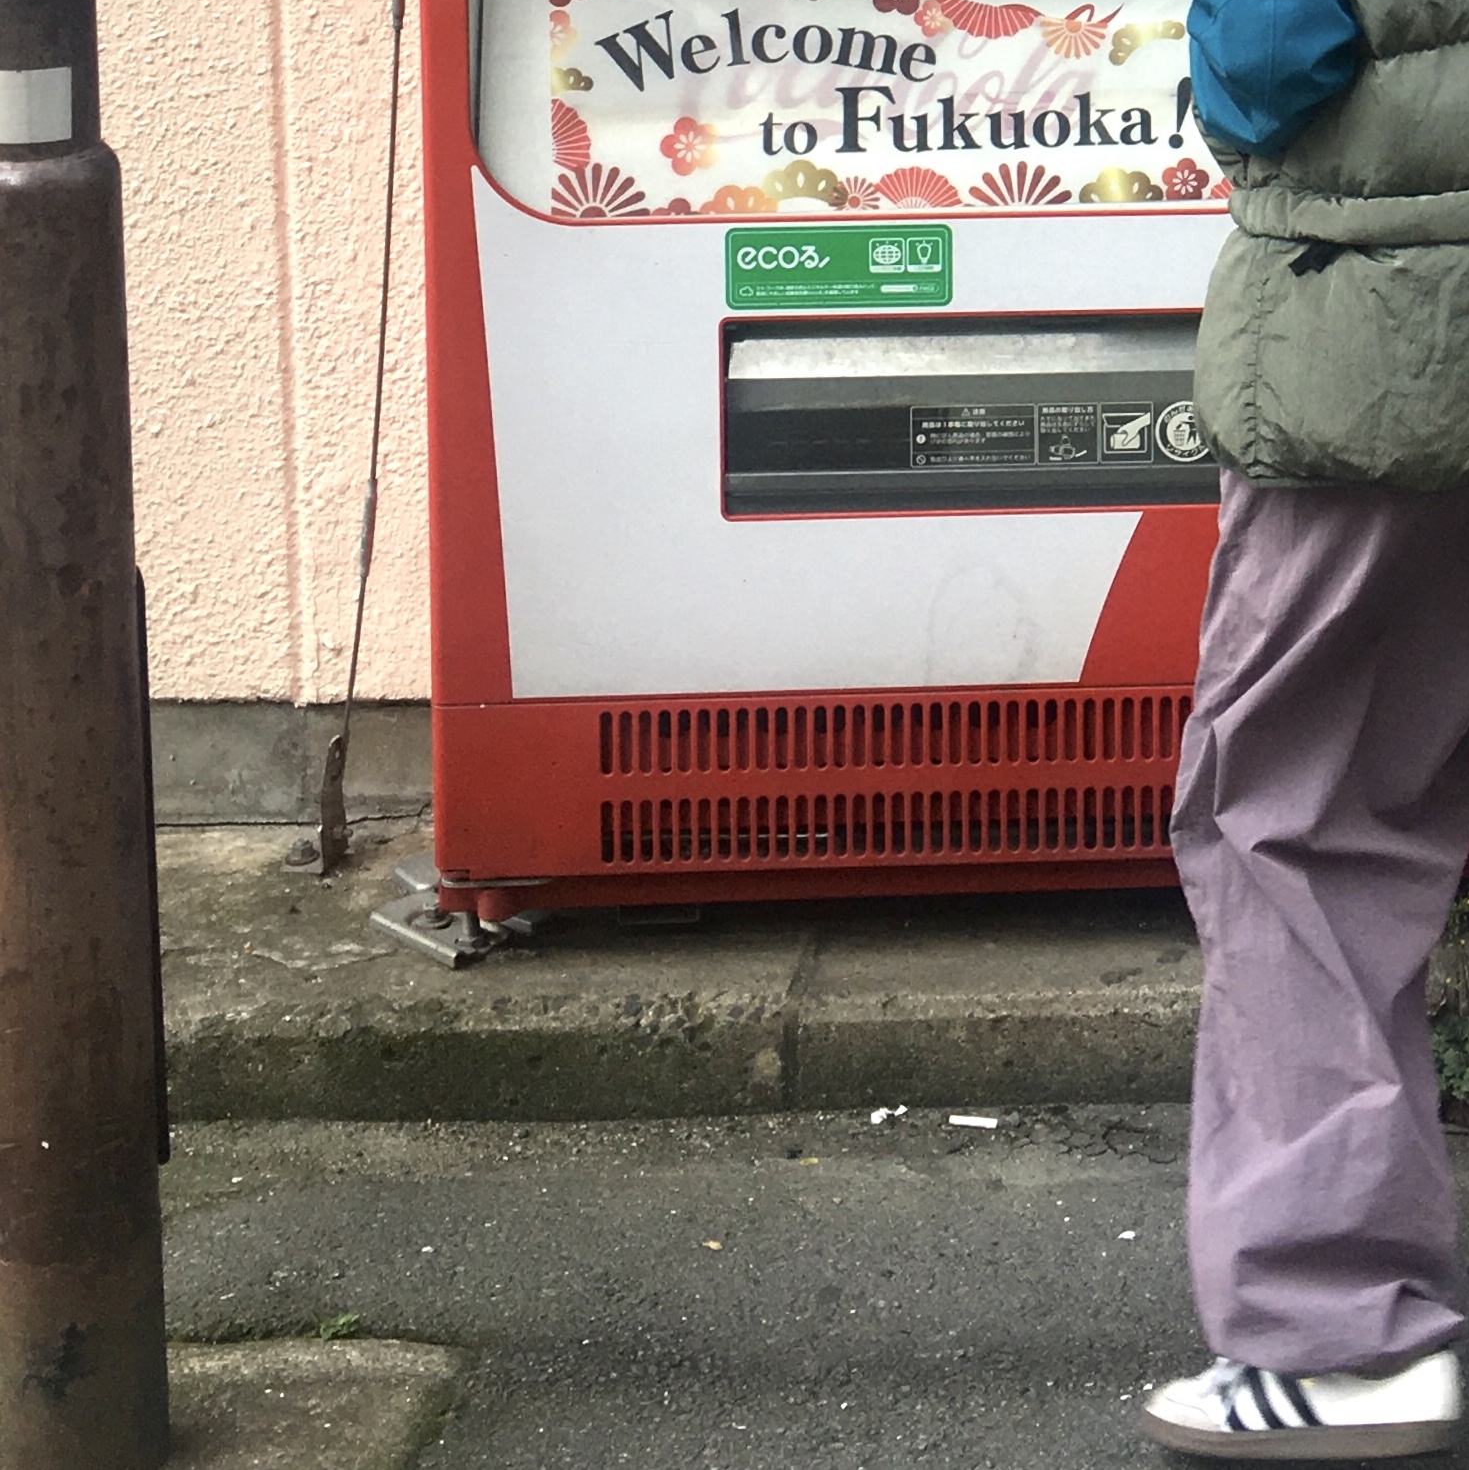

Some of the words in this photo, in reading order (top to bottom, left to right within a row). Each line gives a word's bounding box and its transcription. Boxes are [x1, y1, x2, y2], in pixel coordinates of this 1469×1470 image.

[593, 8, 939, 94] Welcome
[759, 111, 818, 156] to
[833, 76, 1192, 155] Fukuoka!
